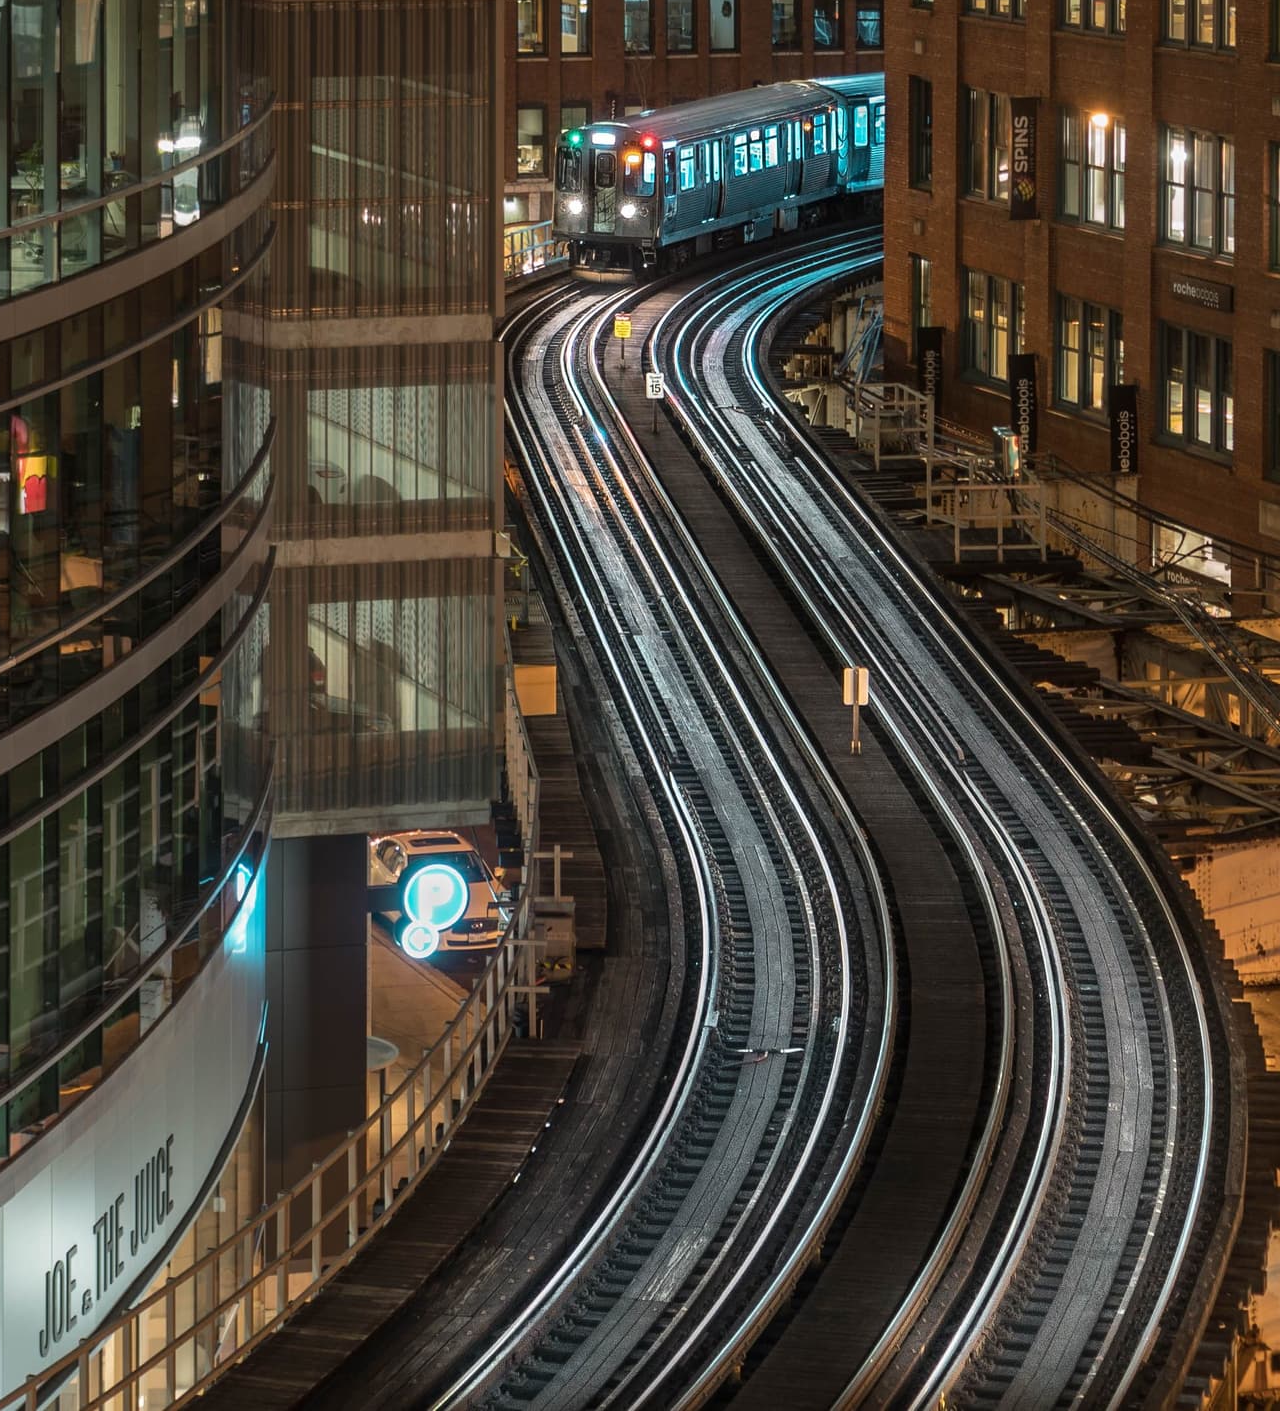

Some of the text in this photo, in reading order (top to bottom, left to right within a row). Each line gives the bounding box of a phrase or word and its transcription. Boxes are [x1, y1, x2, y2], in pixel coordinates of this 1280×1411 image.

[1014, 115, 1029, 173] SPINS
[650, 384, 661, 393] 15
[418, 873, 454, 923] P
[39, 1133, 174, 1358] JOE & THE JUICE
